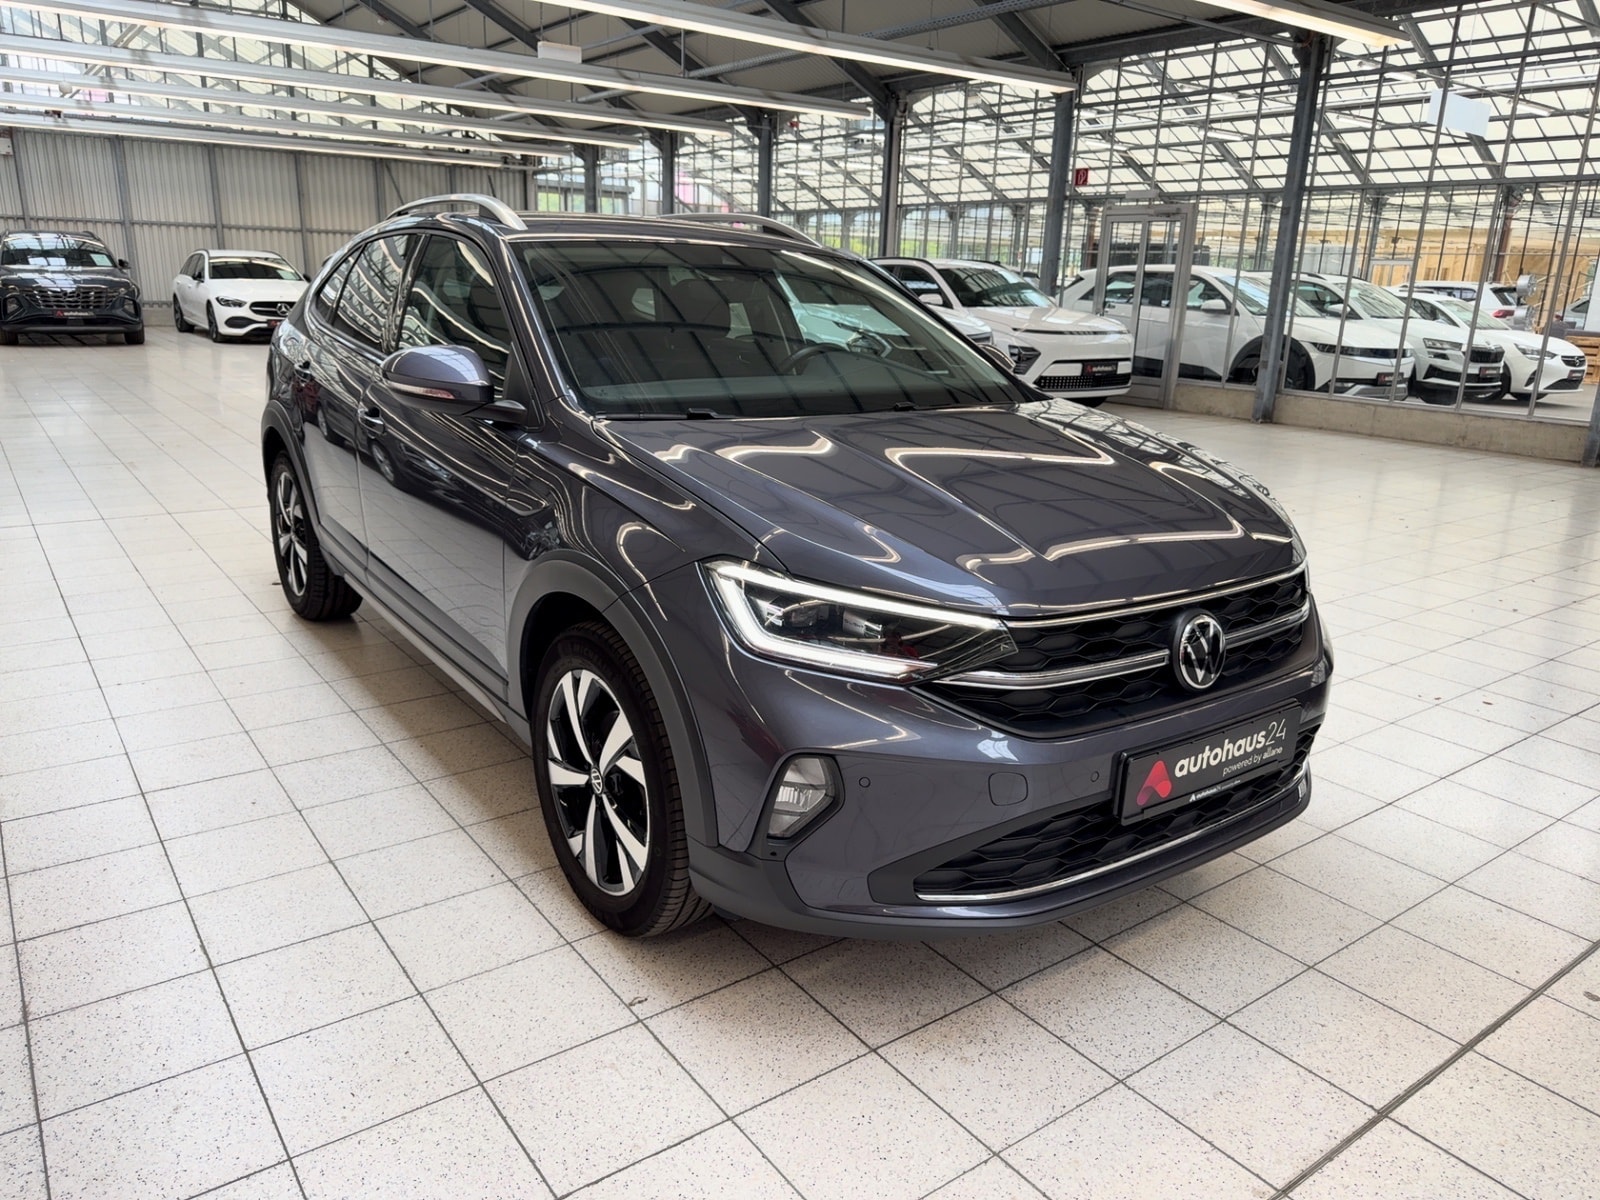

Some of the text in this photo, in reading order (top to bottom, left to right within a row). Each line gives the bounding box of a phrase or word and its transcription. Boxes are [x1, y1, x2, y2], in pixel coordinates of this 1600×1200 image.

[1174, 718, 1286, 777] autohaus24
[1222, 746, 1283, 777] powered by allane
